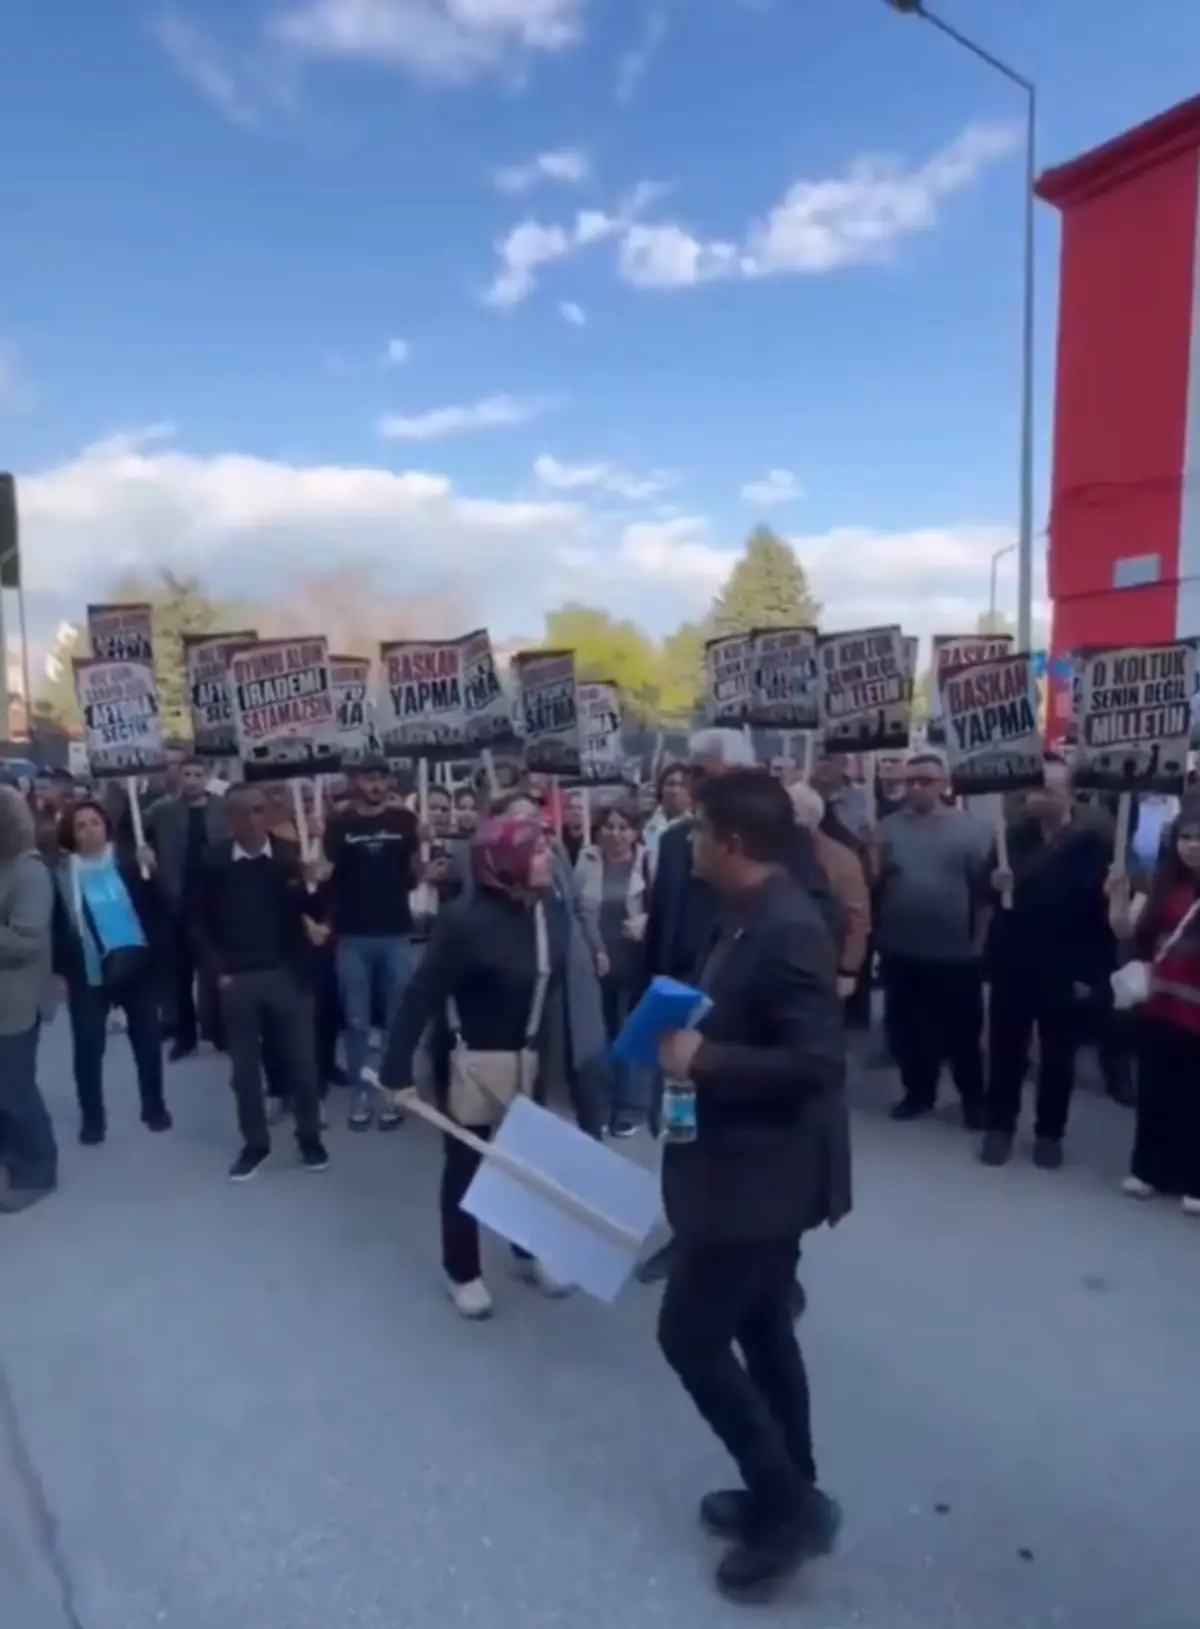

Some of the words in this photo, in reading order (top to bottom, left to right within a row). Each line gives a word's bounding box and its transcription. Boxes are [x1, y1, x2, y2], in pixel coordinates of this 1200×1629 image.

[1113, 650, 1186, 685] KOLTUK
[390, 678, 461, 715] YAPMA
[952, 697, 1035, 749] YAPMA
